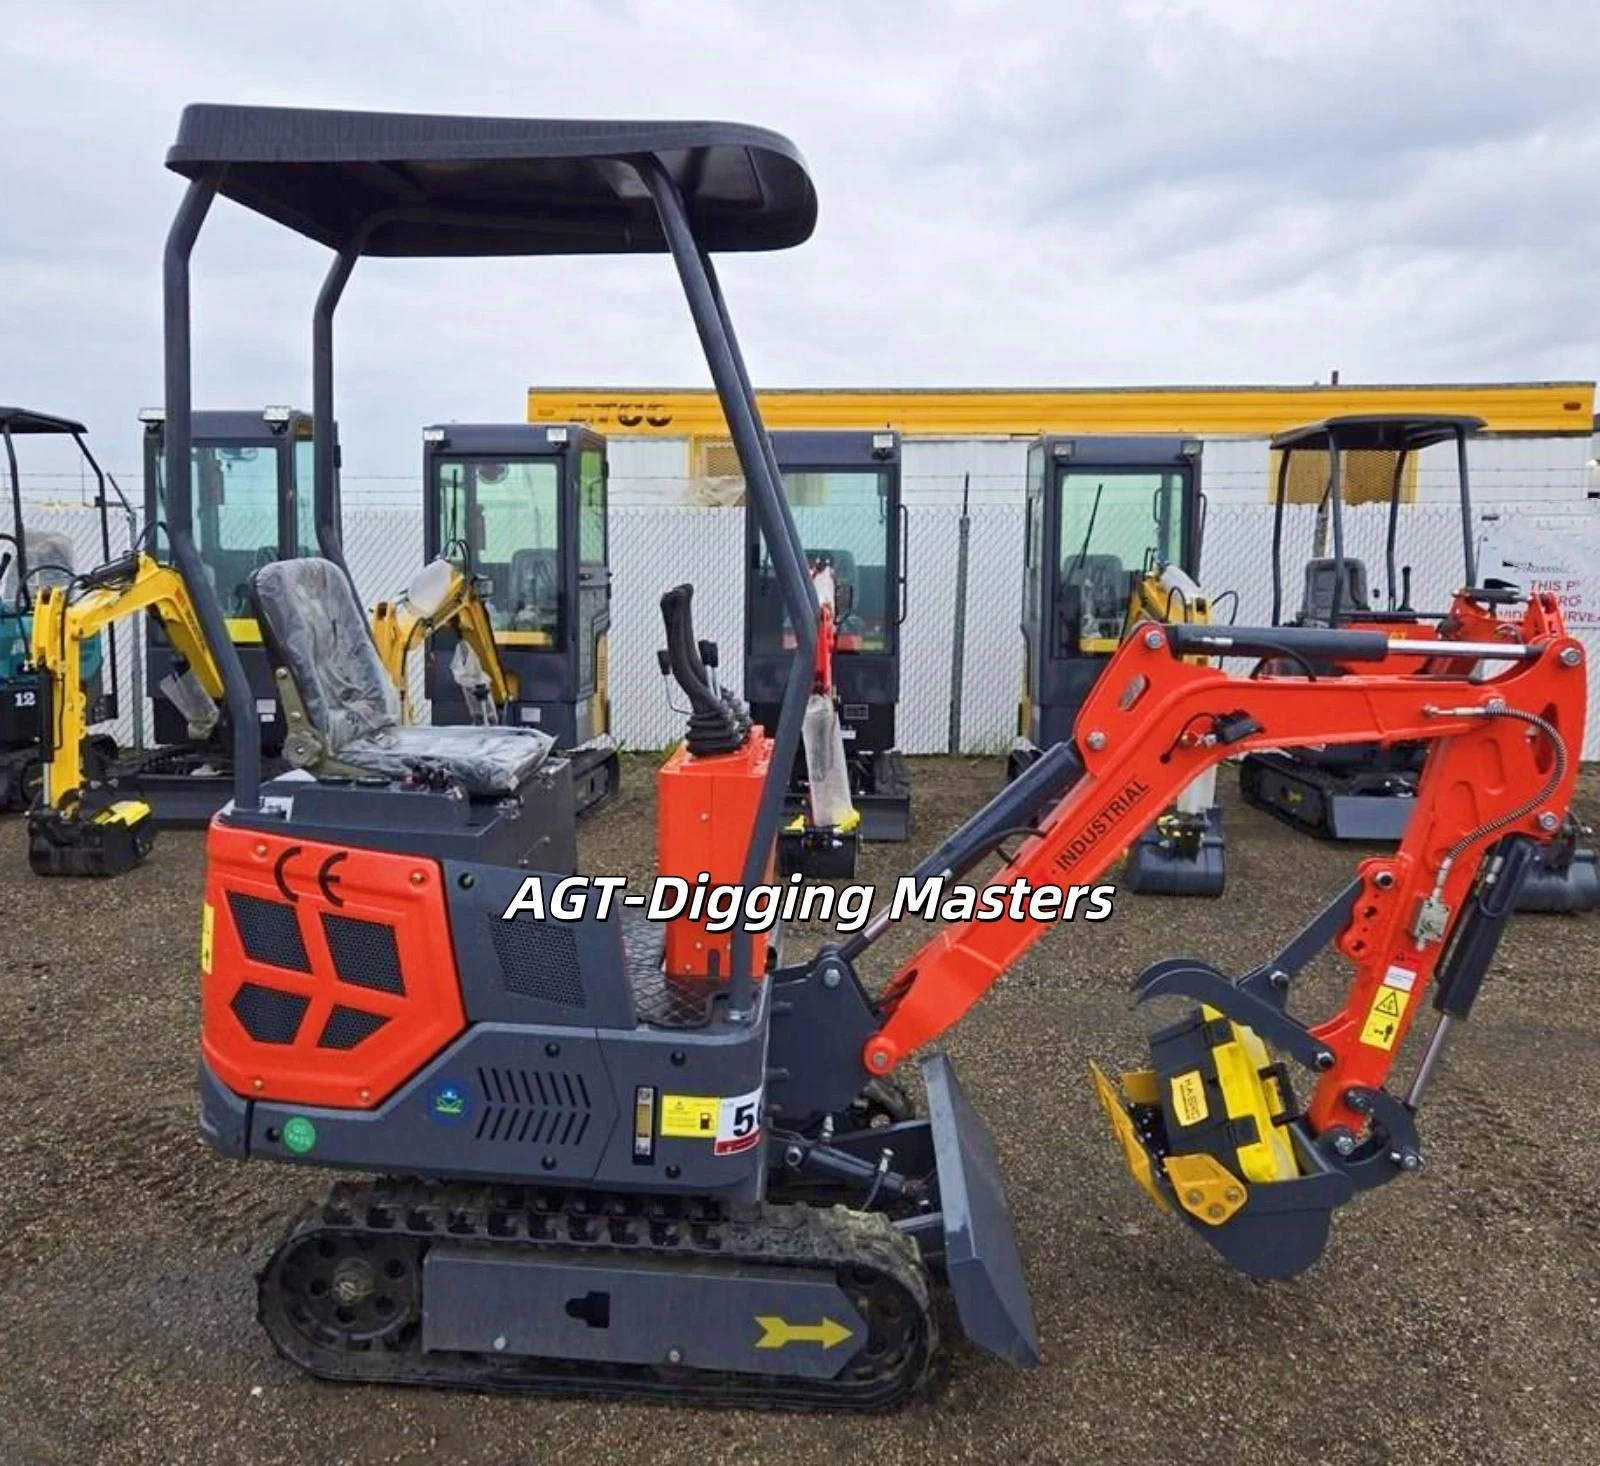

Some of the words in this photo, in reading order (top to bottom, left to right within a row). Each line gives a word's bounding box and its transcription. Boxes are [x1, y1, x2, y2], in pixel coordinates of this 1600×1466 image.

[1530, 580, 1561, 591] THIS
[14, 692, 36, 707] 12
[1057, 782, 1148, 871] INDUSTRIAL
[733, 1101, 762, 1137] 5
